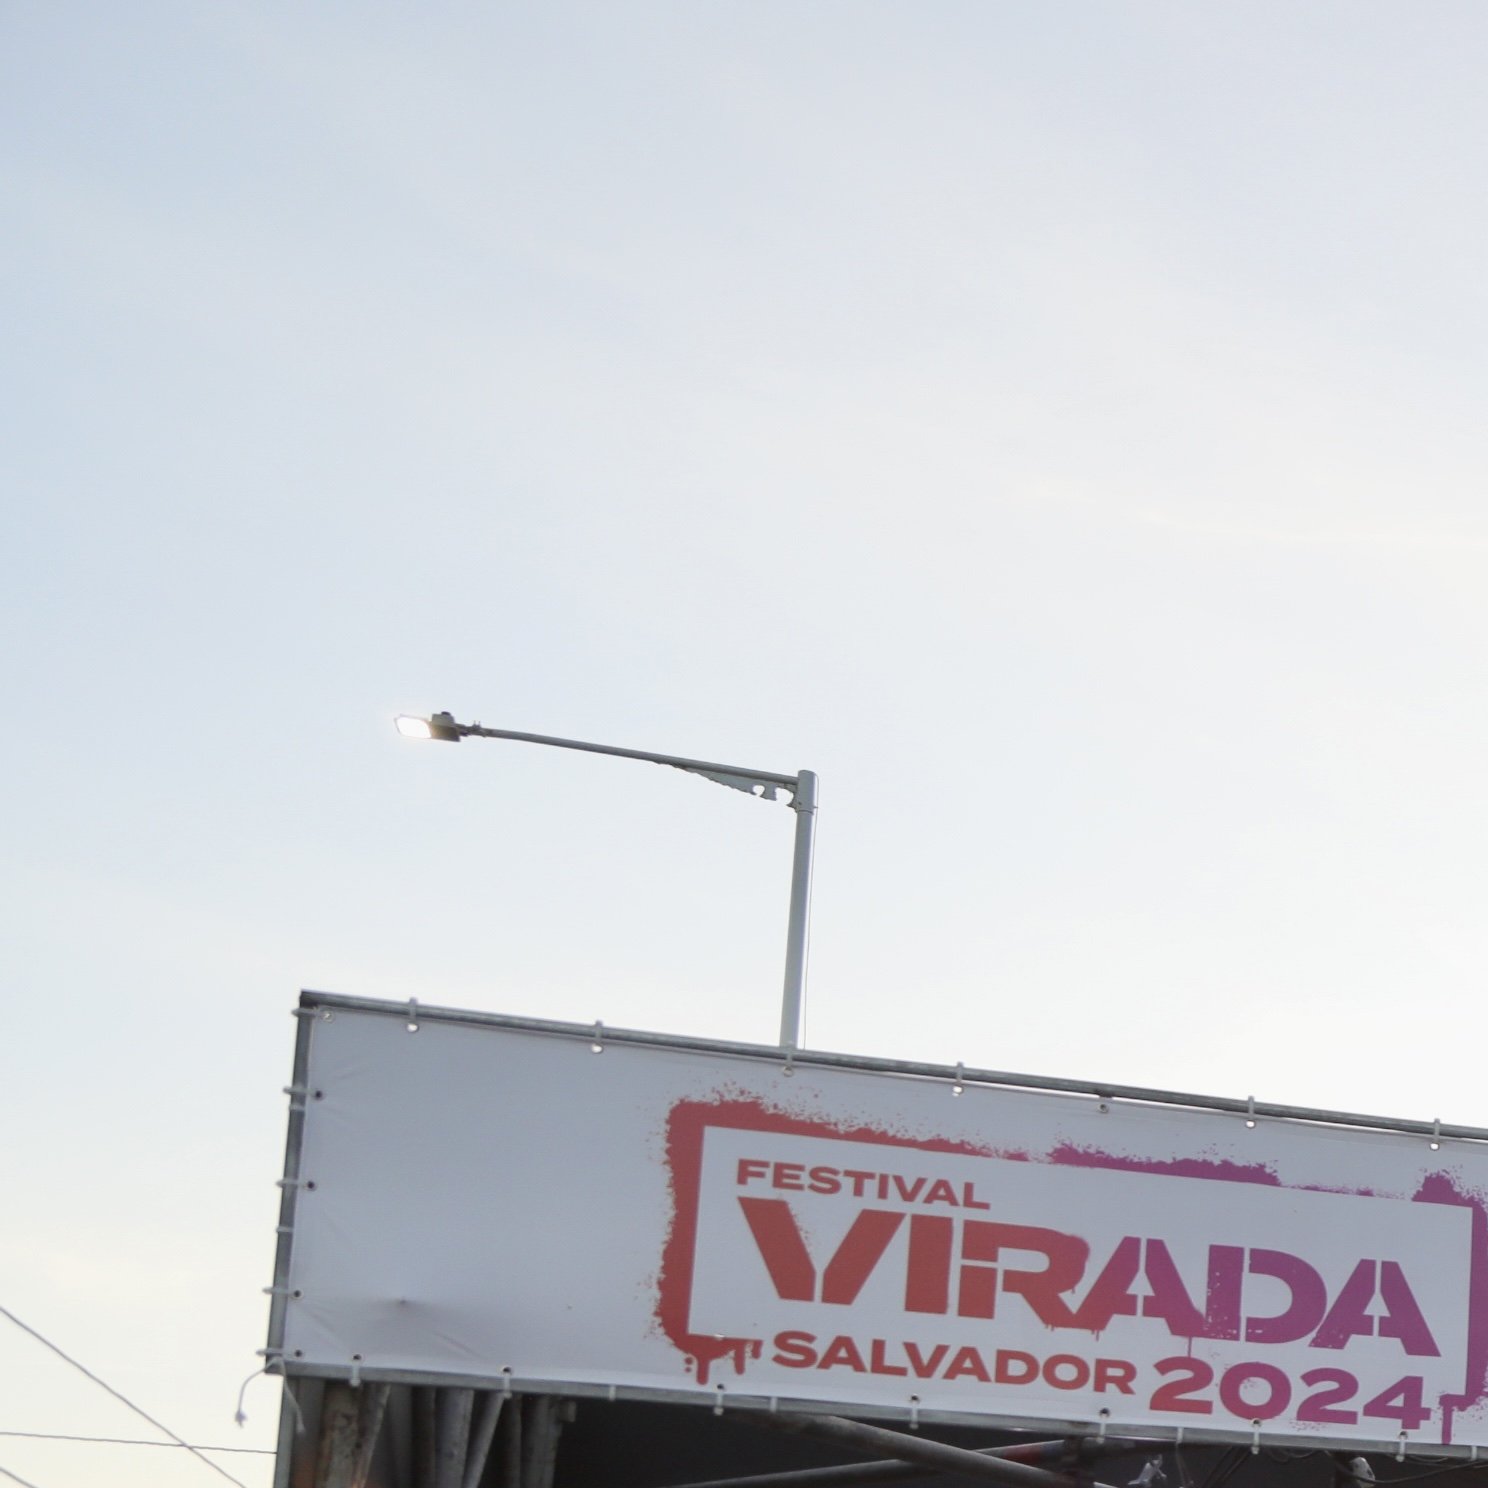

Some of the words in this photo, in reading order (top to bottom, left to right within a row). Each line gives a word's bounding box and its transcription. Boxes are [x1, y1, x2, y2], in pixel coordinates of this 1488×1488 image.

[736, 1158, 990, 1211] FESTIVAL
[736, 1197, 1442, 1357] VIRADA
[772, 1331, 1137, 1395] SALVADOR
[1149, 1356, 1432, 1431] 2024
